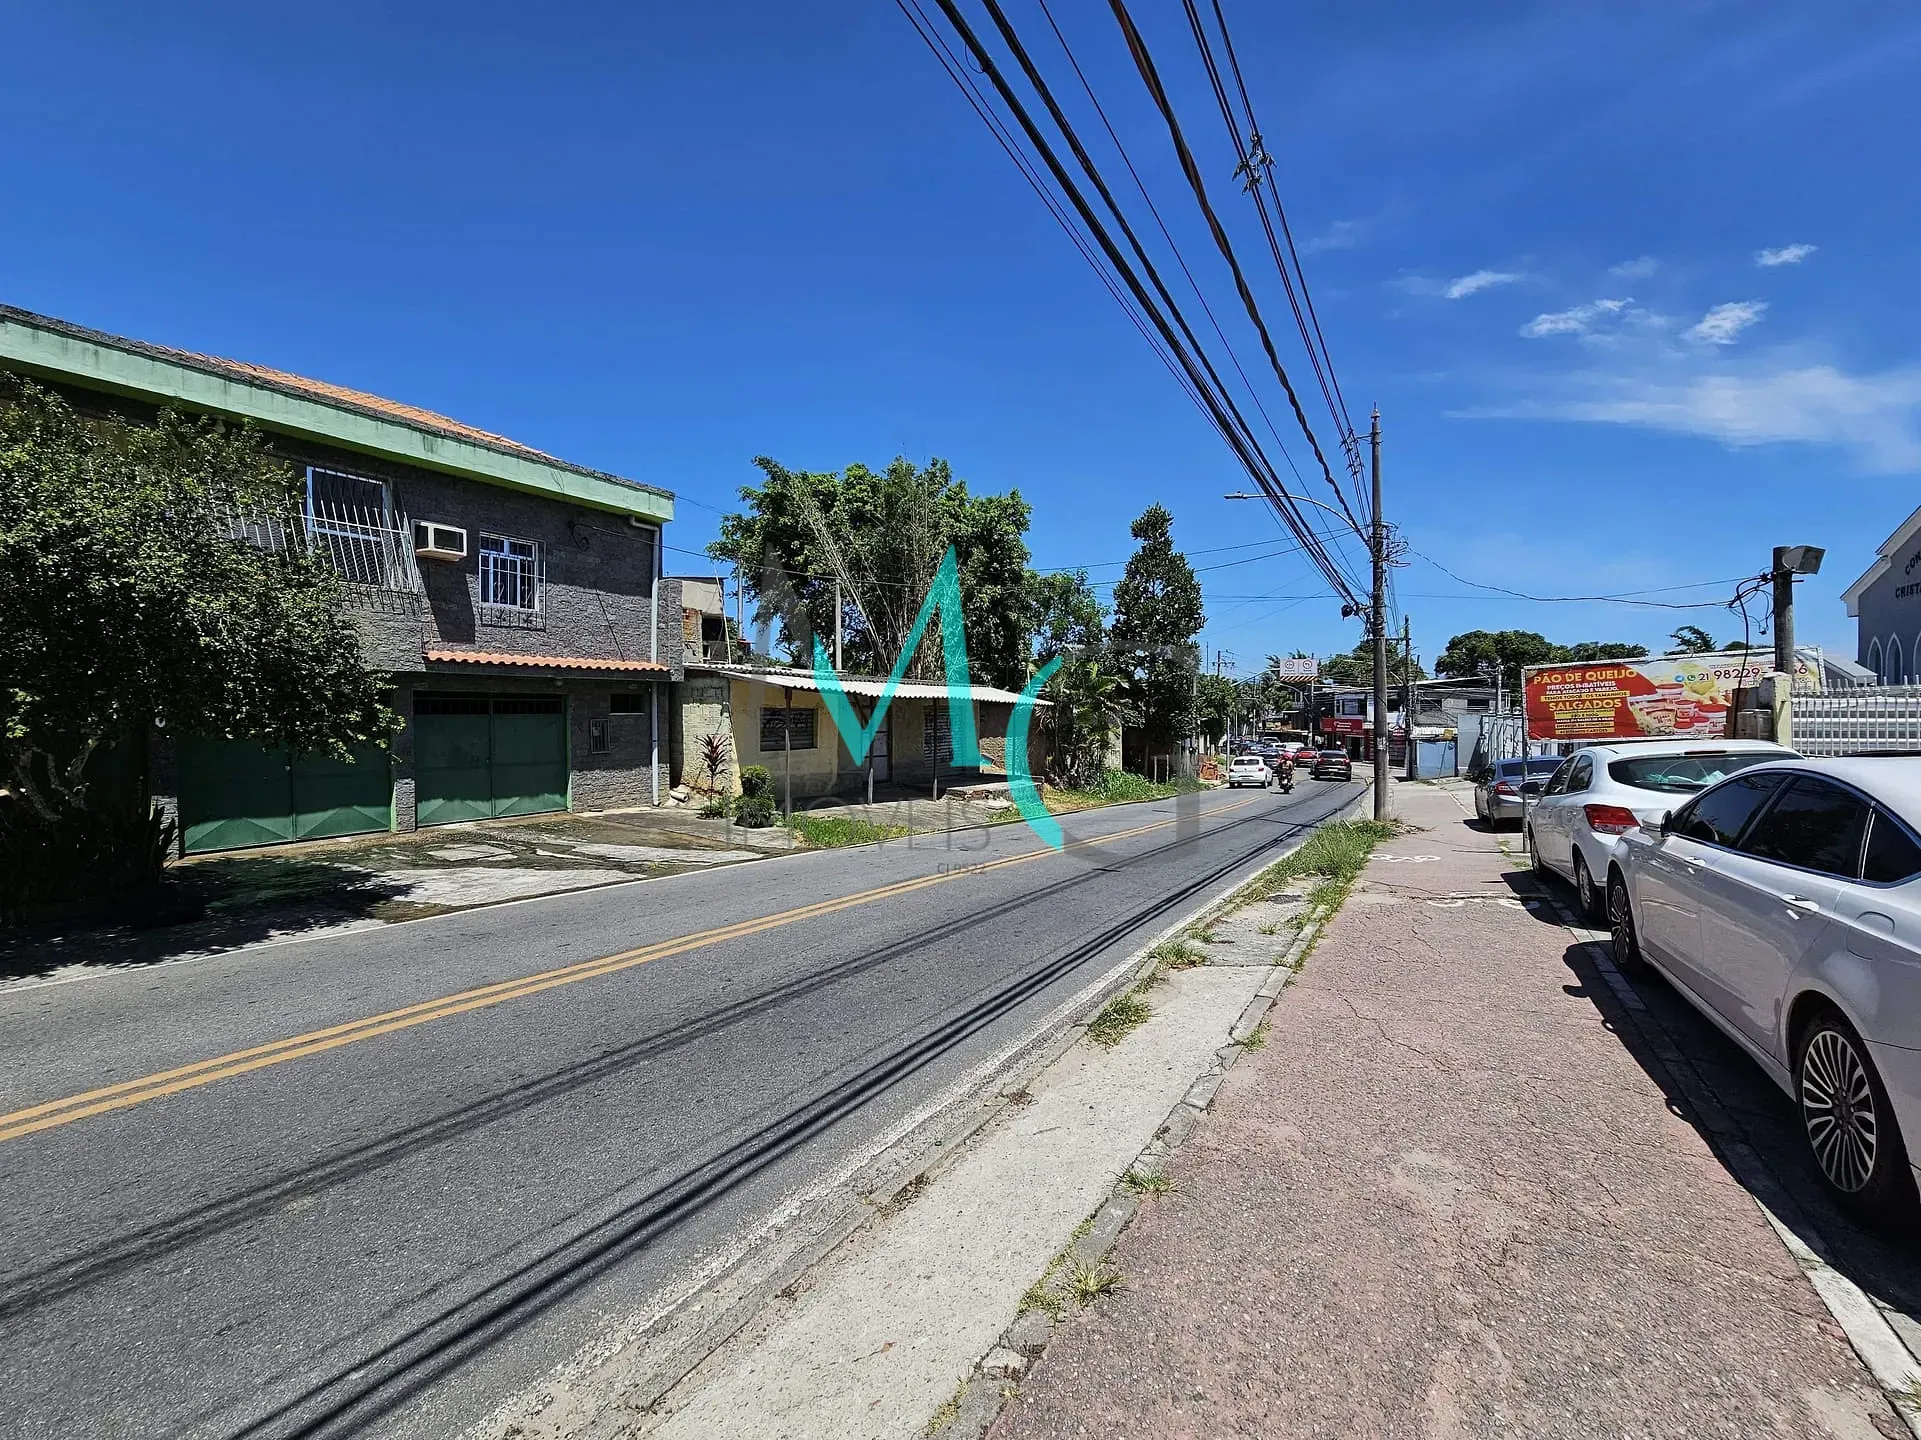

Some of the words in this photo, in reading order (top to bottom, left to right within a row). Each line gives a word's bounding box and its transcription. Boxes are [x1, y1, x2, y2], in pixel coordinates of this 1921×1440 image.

[1895, 582, 1921, 598] CRIST
[1533, 673, 1562, 685] PÃO
[1565, 672, 1582, 682] DE
[1585, 669, 1637, 681] QUEIJO
[1698, 673, 1709, 681] 21
[1546, 683, 1575, 692] PREÇOS
[1576, 680, 1616, 690] IMBATÍVEIS
[1549, 699, 1622, 711] SALGADOS
